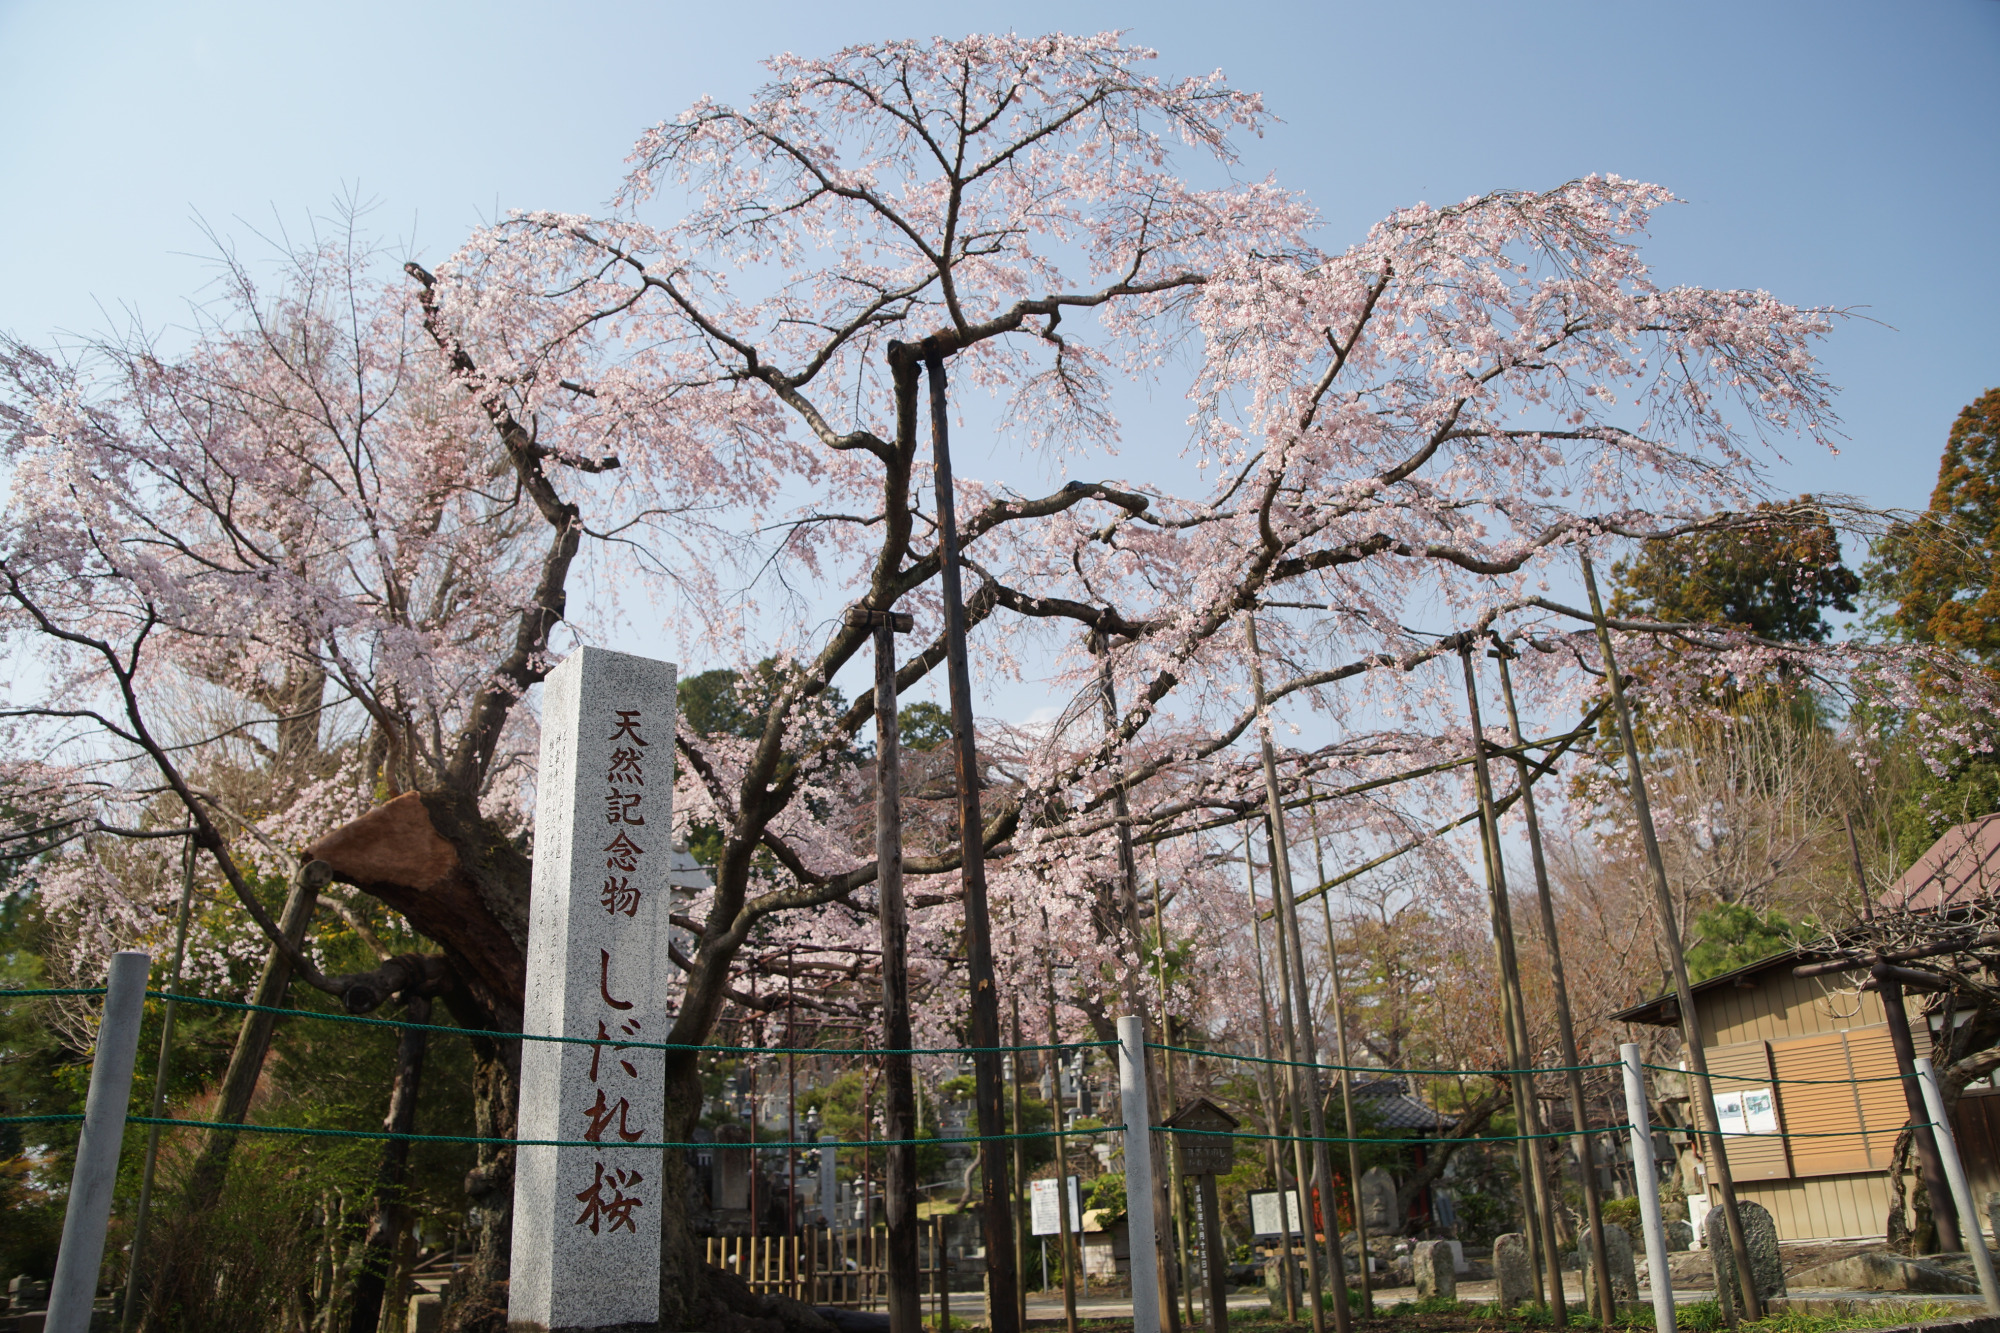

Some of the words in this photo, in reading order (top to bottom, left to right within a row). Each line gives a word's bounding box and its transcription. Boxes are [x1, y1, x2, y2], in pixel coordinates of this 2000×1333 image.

[600, 710, 649, 918] 天然記念物
[575, 948, 645, 1237] しだれ桜
